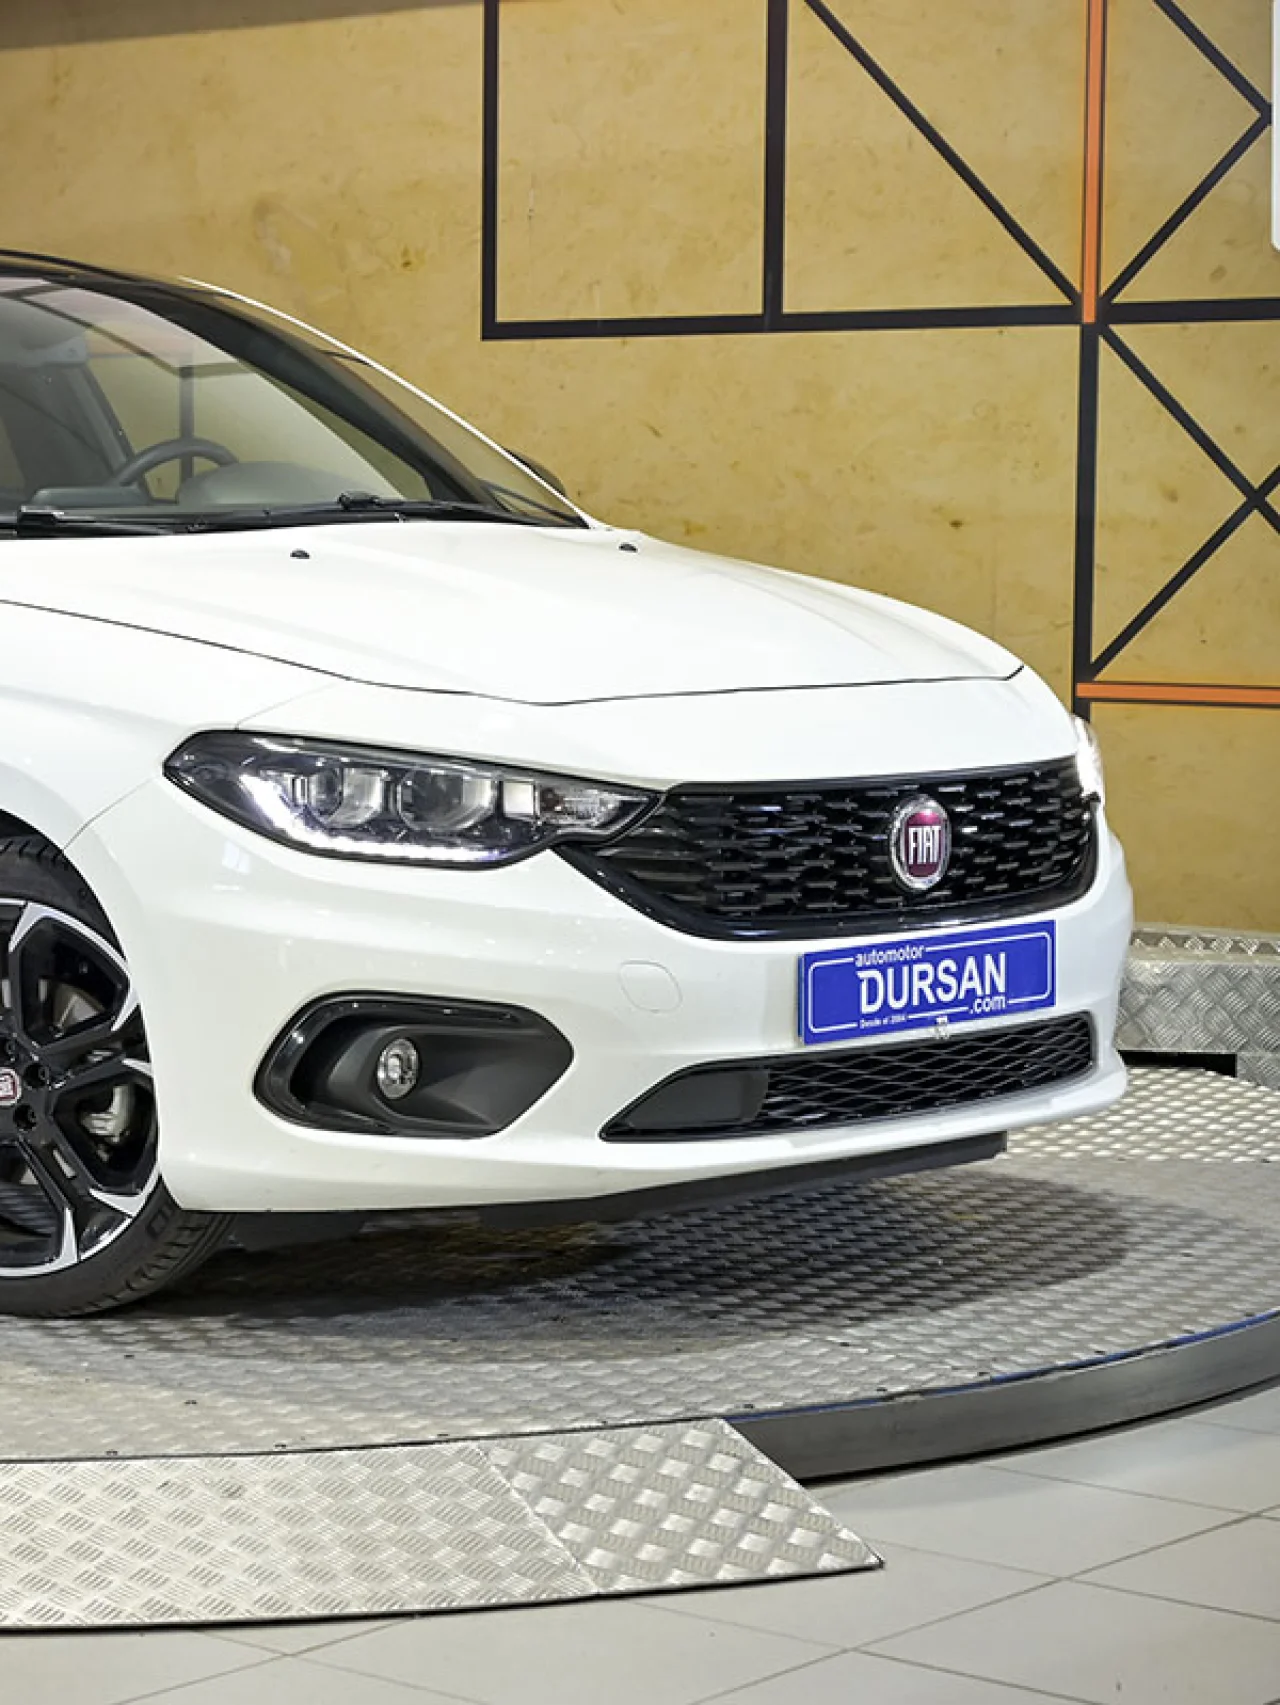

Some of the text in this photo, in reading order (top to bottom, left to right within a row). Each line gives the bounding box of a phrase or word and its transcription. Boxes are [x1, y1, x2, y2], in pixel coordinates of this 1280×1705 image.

[908, 825, 941, 864] FIAT
[855, 945, 924, 967] automotor
[856, 952, 1006, 1015] DURSAN
[970, 995, 1007, 1015] .com
